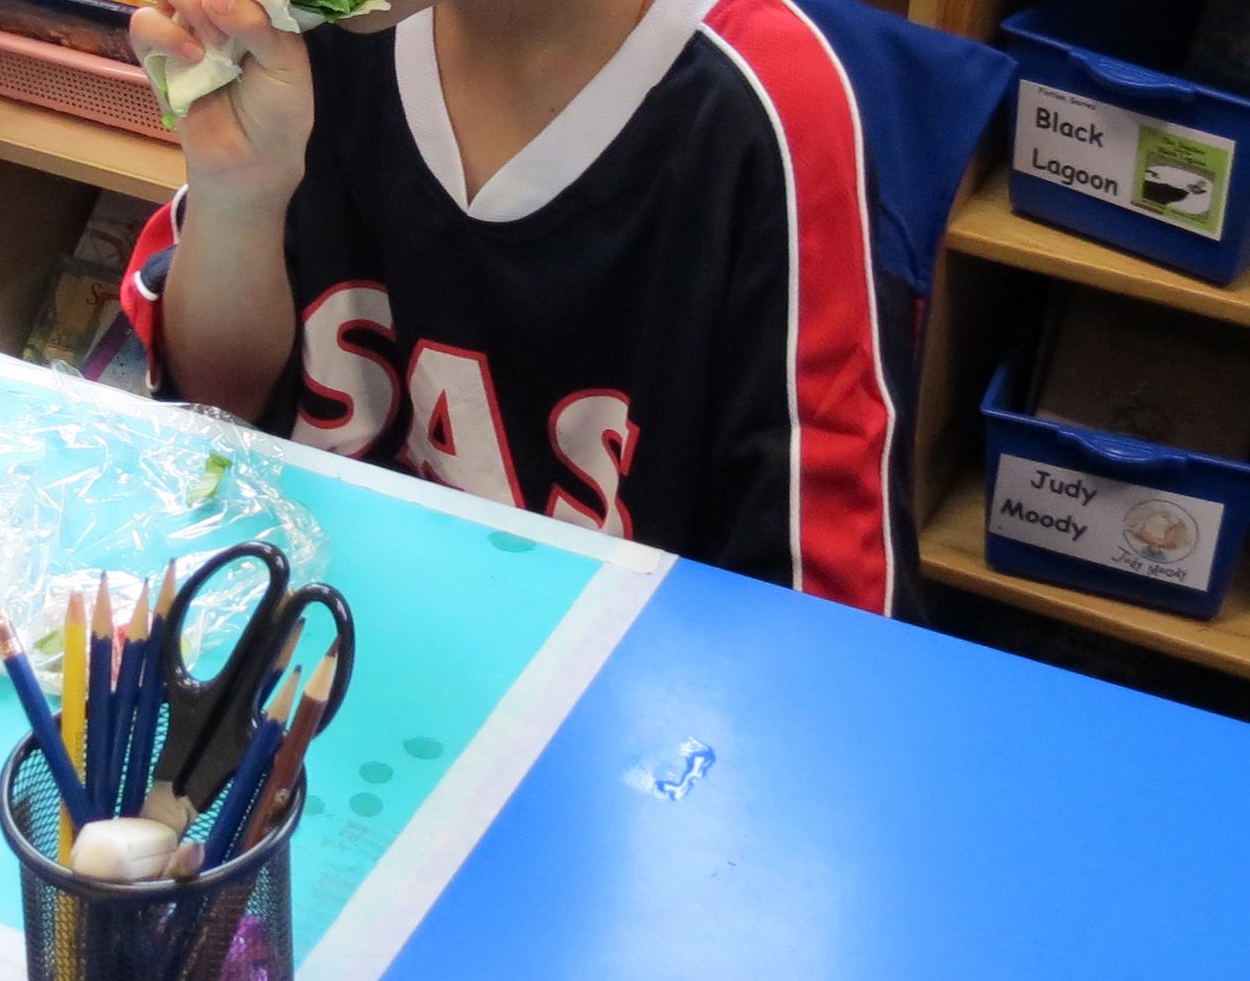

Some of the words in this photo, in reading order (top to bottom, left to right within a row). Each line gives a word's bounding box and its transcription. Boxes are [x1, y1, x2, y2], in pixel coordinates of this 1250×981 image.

[1035, 107, 1104, 148] Black
[1031, 147, 1119, 196] Lagoon
[291, 280, 640, 540] SAS
[1030, 469, 1097, 507] Judy
[1000, 497, 1088, 542] Moody
